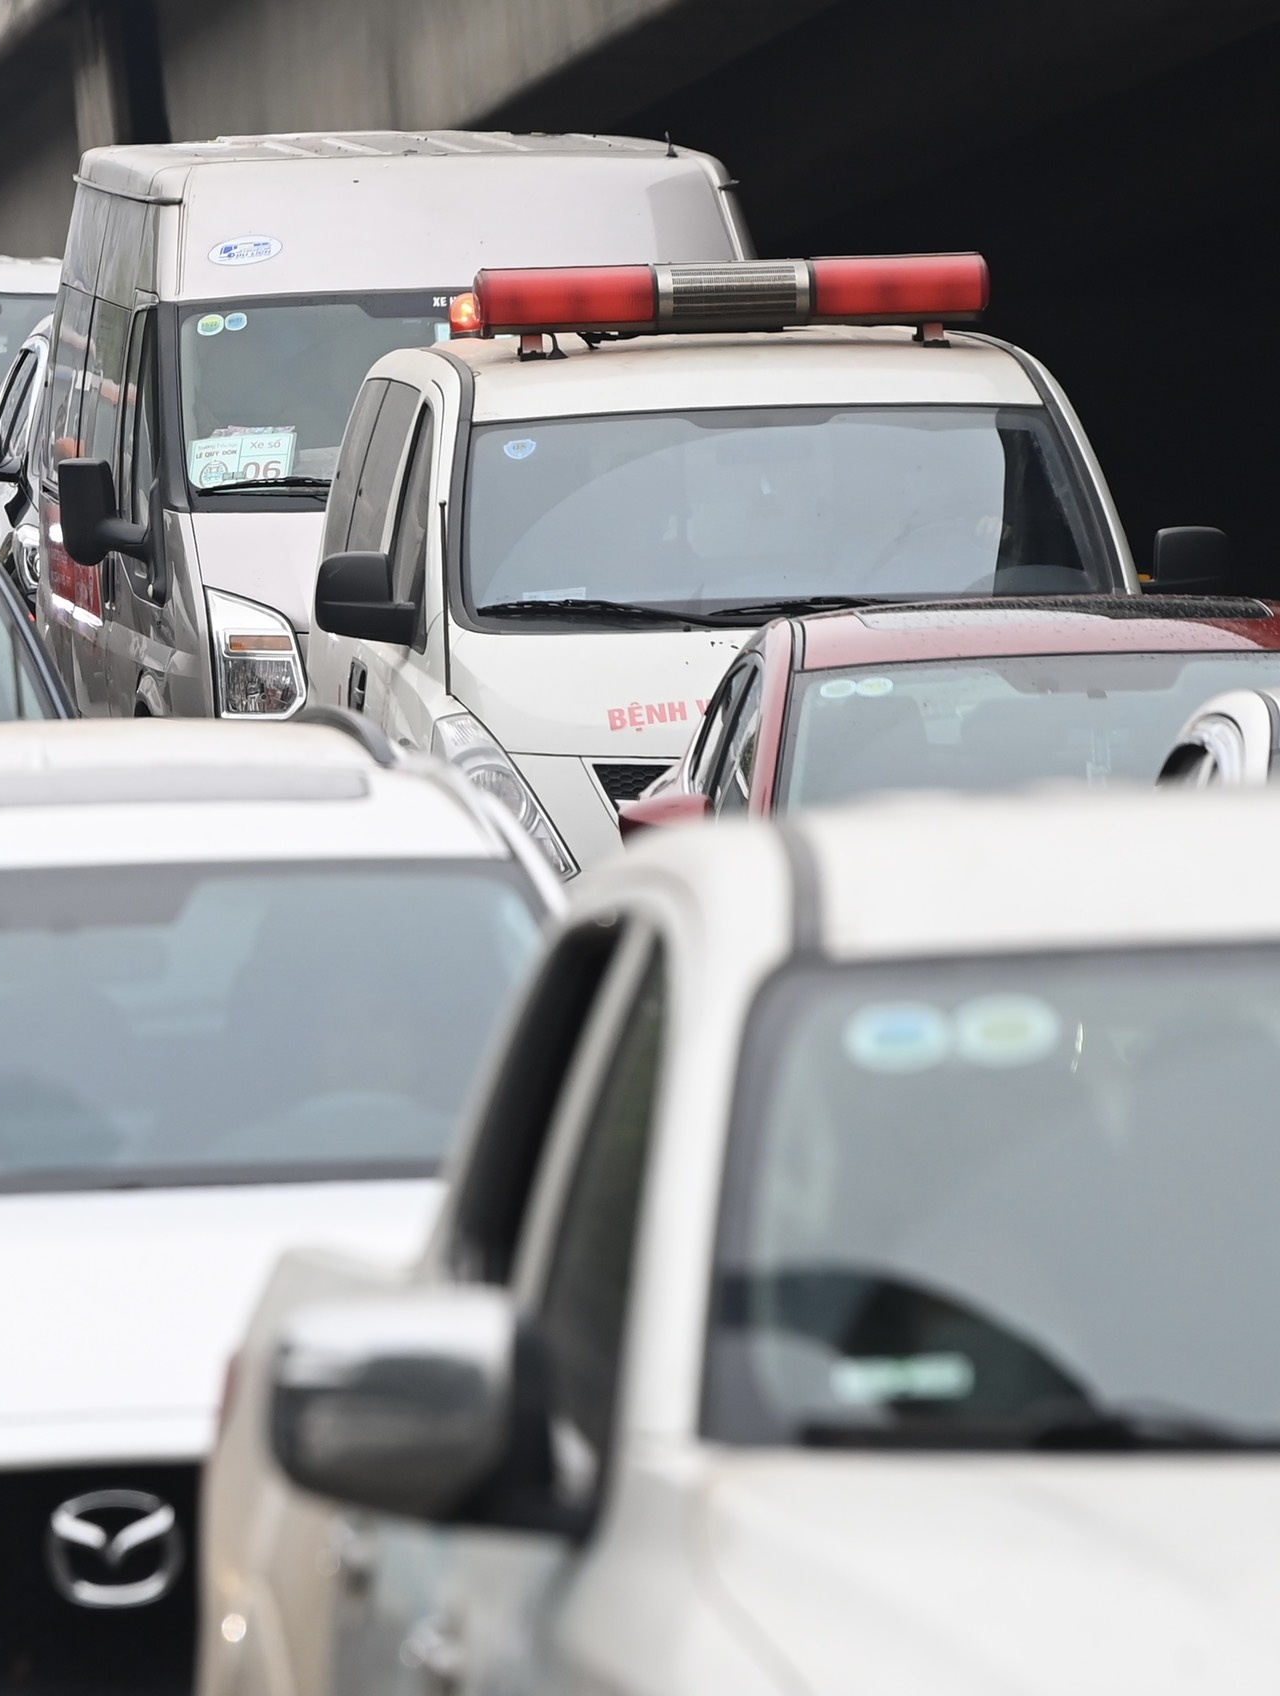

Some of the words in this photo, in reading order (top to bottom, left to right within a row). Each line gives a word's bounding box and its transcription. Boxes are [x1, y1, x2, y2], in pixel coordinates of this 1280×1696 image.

[432, 296, 447, 307] XE
[250, 441, 264, 449] Xe
[267, 439, 281, 448] số
[242, 460, 282, 479] 06
[608, 702, 687, 731] BỆNH
